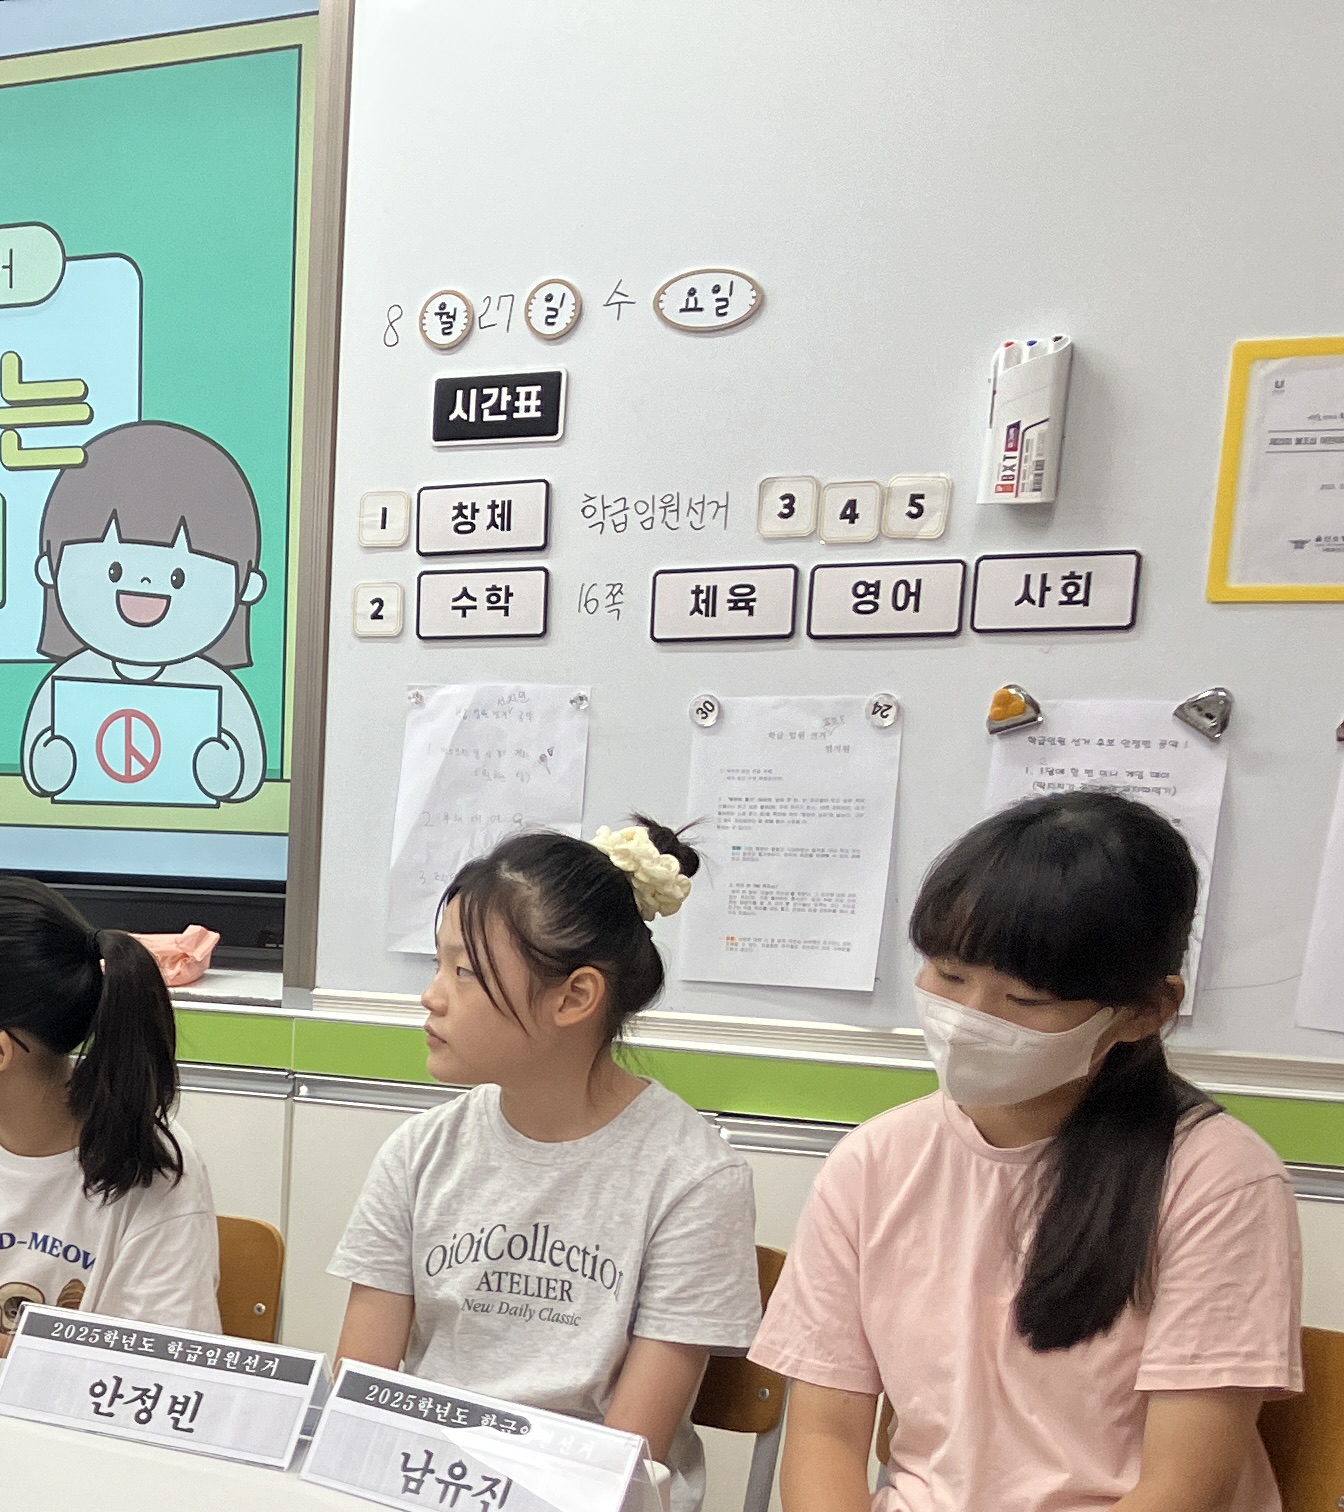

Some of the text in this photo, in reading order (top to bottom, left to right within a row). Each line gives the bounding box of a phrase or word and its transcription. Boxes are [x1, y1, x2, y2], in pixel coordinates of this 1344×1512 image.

[383, 279, 734, 347] 8 월 27 일 수 요일
[448, 384, 543, 423] 시간표
[1000, 454, 1018, 482] BXT
[450, 499, 513, 535] 창체
[581, 491, 730, 535] 학급임원선거
[776, 493, 796, 520] 3
[839, 498, 860, 525] 4
[904, 492, 925, 520] 5
[369, 584, 514, 621] 2 수학
[577, 582, 625, 622] 16쪽
[688, 582, 758, 619] 체육
[850, 577, 924, 616] 영어
[1013, 570, 1093, 609] 사회
[695, 699, 716, 720] 30
[871, 701, 893, 720] 24
[474, 1270, 574, 1303] ATELIER
[461, 1298, 582, 1328] New Daily Classic
[49, 1321, 280, 1380] 2025학년도 학급임원선거
[87, 1374, 205, 1435] 안정빈
[364, 1383, 471, 1427] 2025학년도
